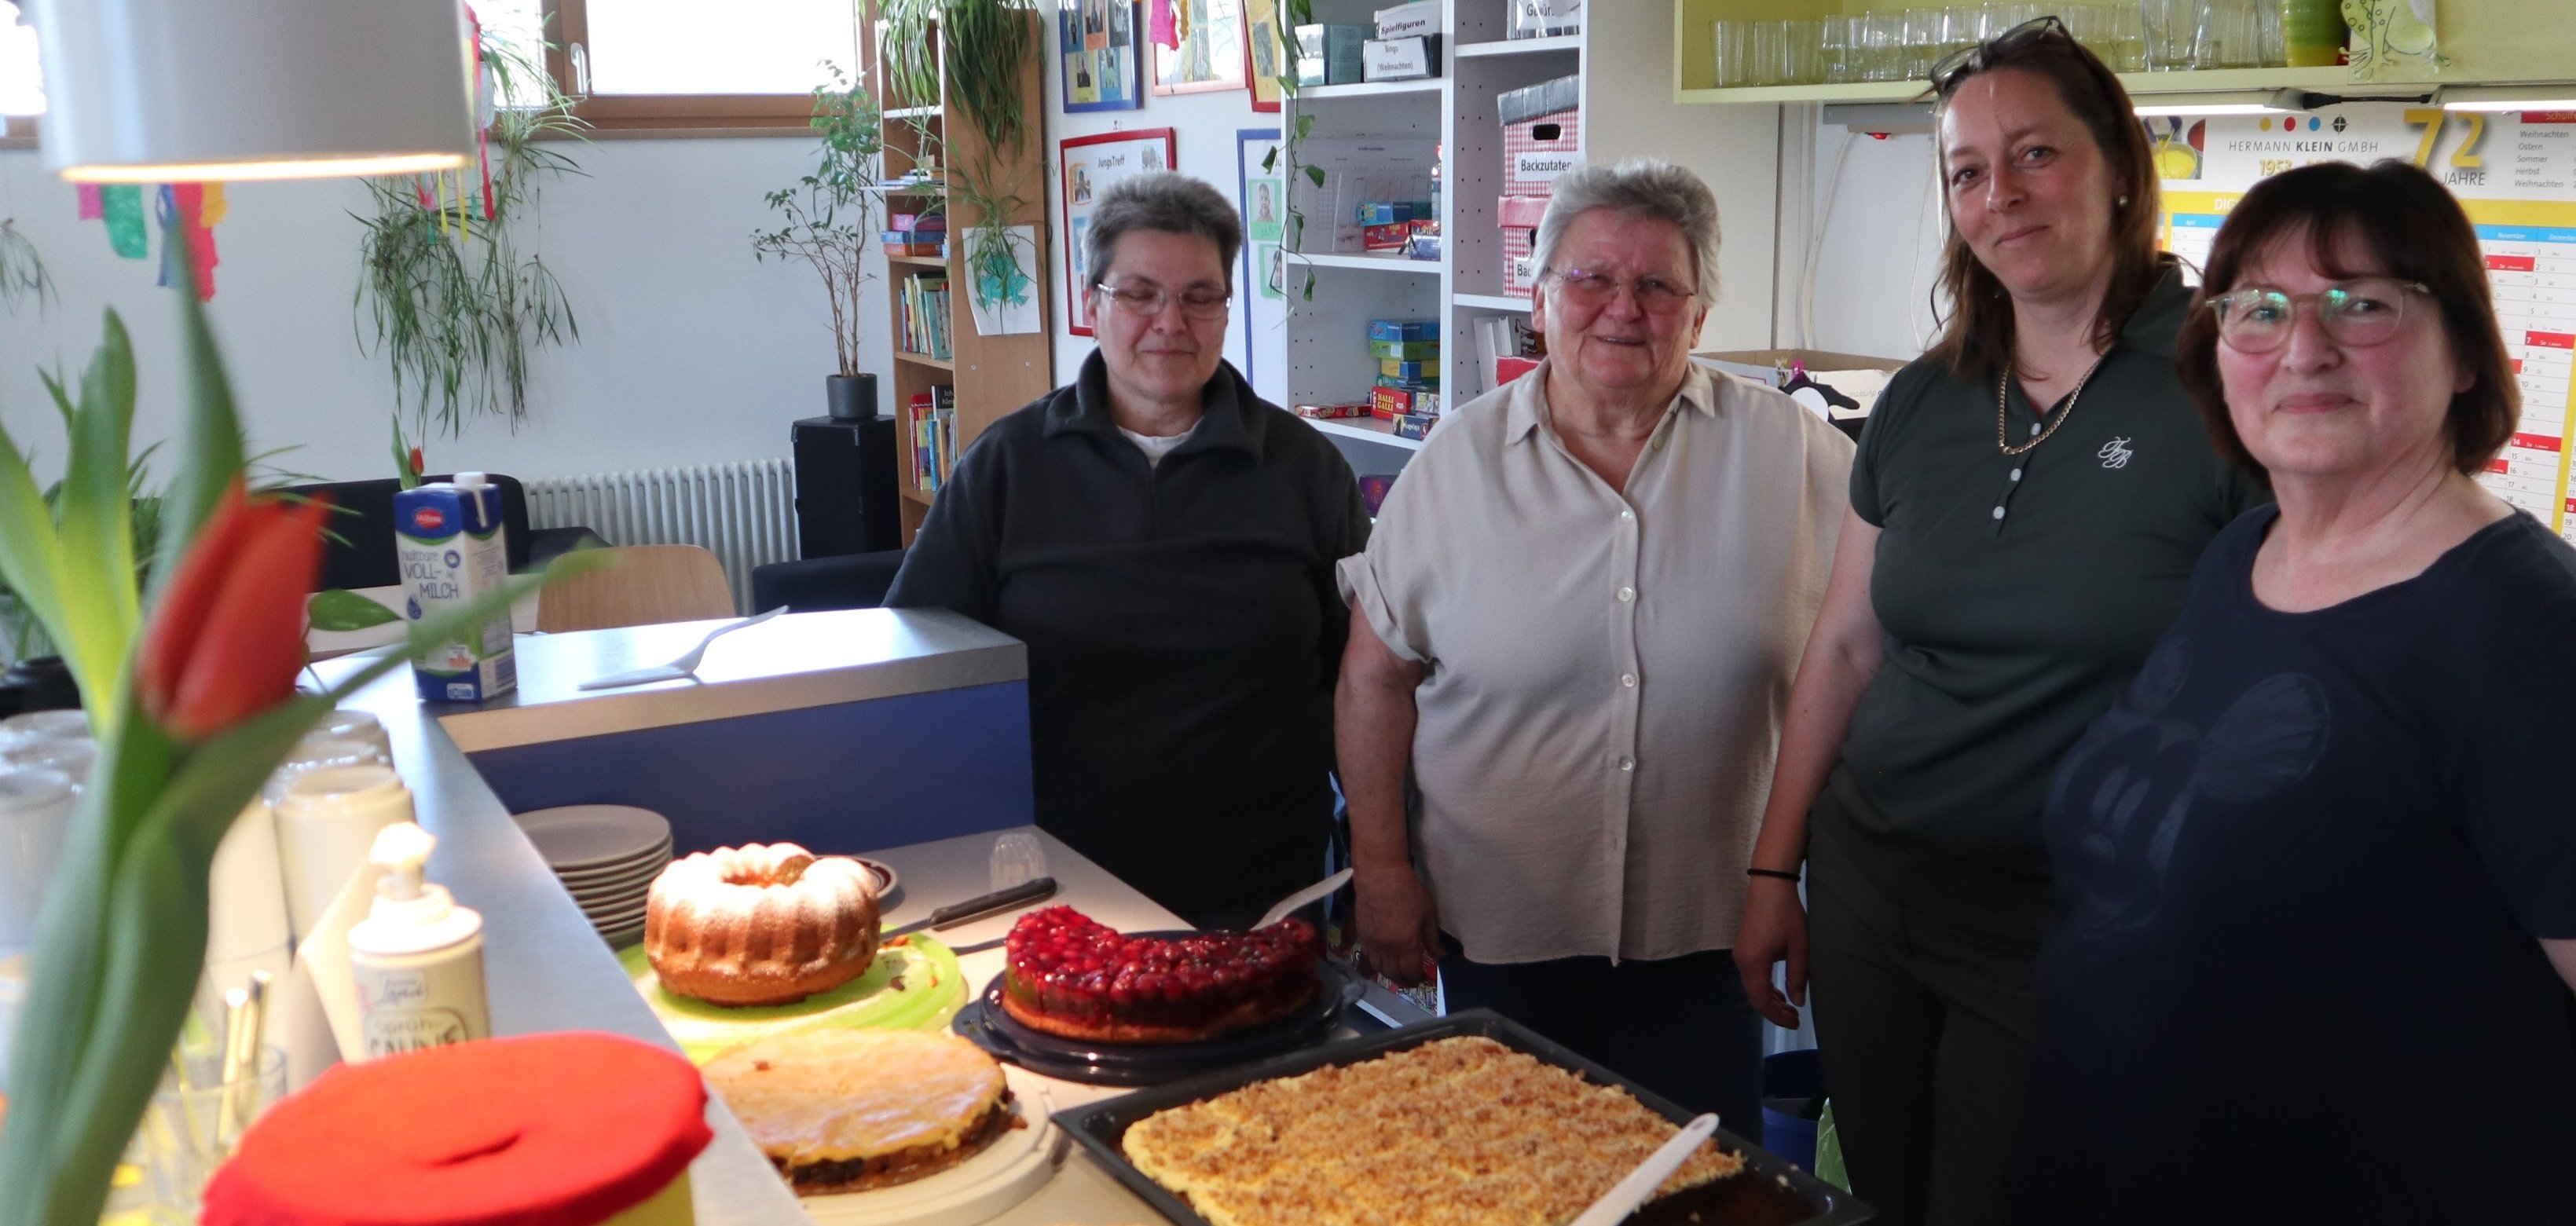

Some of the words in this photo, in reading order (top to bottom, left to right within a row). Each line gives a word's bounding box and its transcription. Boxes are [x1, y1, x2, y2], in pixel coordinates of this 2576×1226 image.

[1380, 20, 1426, 35] Spielfiguren
[2403, 108, 2484, 170] 72
[2519, 130, 2569, 139] Weihnachten
[2229, 141, 2292, 152] HERMANN
[2296, 141, 2334, 152] KLEIN
[2338, 141, 2379, 153] GMBH
[2516, 156, 2549, 164] Sommer
[2442, 171, 2486, 186] JAHRE
[1378, 393, 1394, 404] HALLI
[1377, 401, 1394, 412] GALLI
[2513, 437, 2520, 446] 14
[404, 562, 442, 580] VOLL-
[420, 582, 459, 599] MILCH
